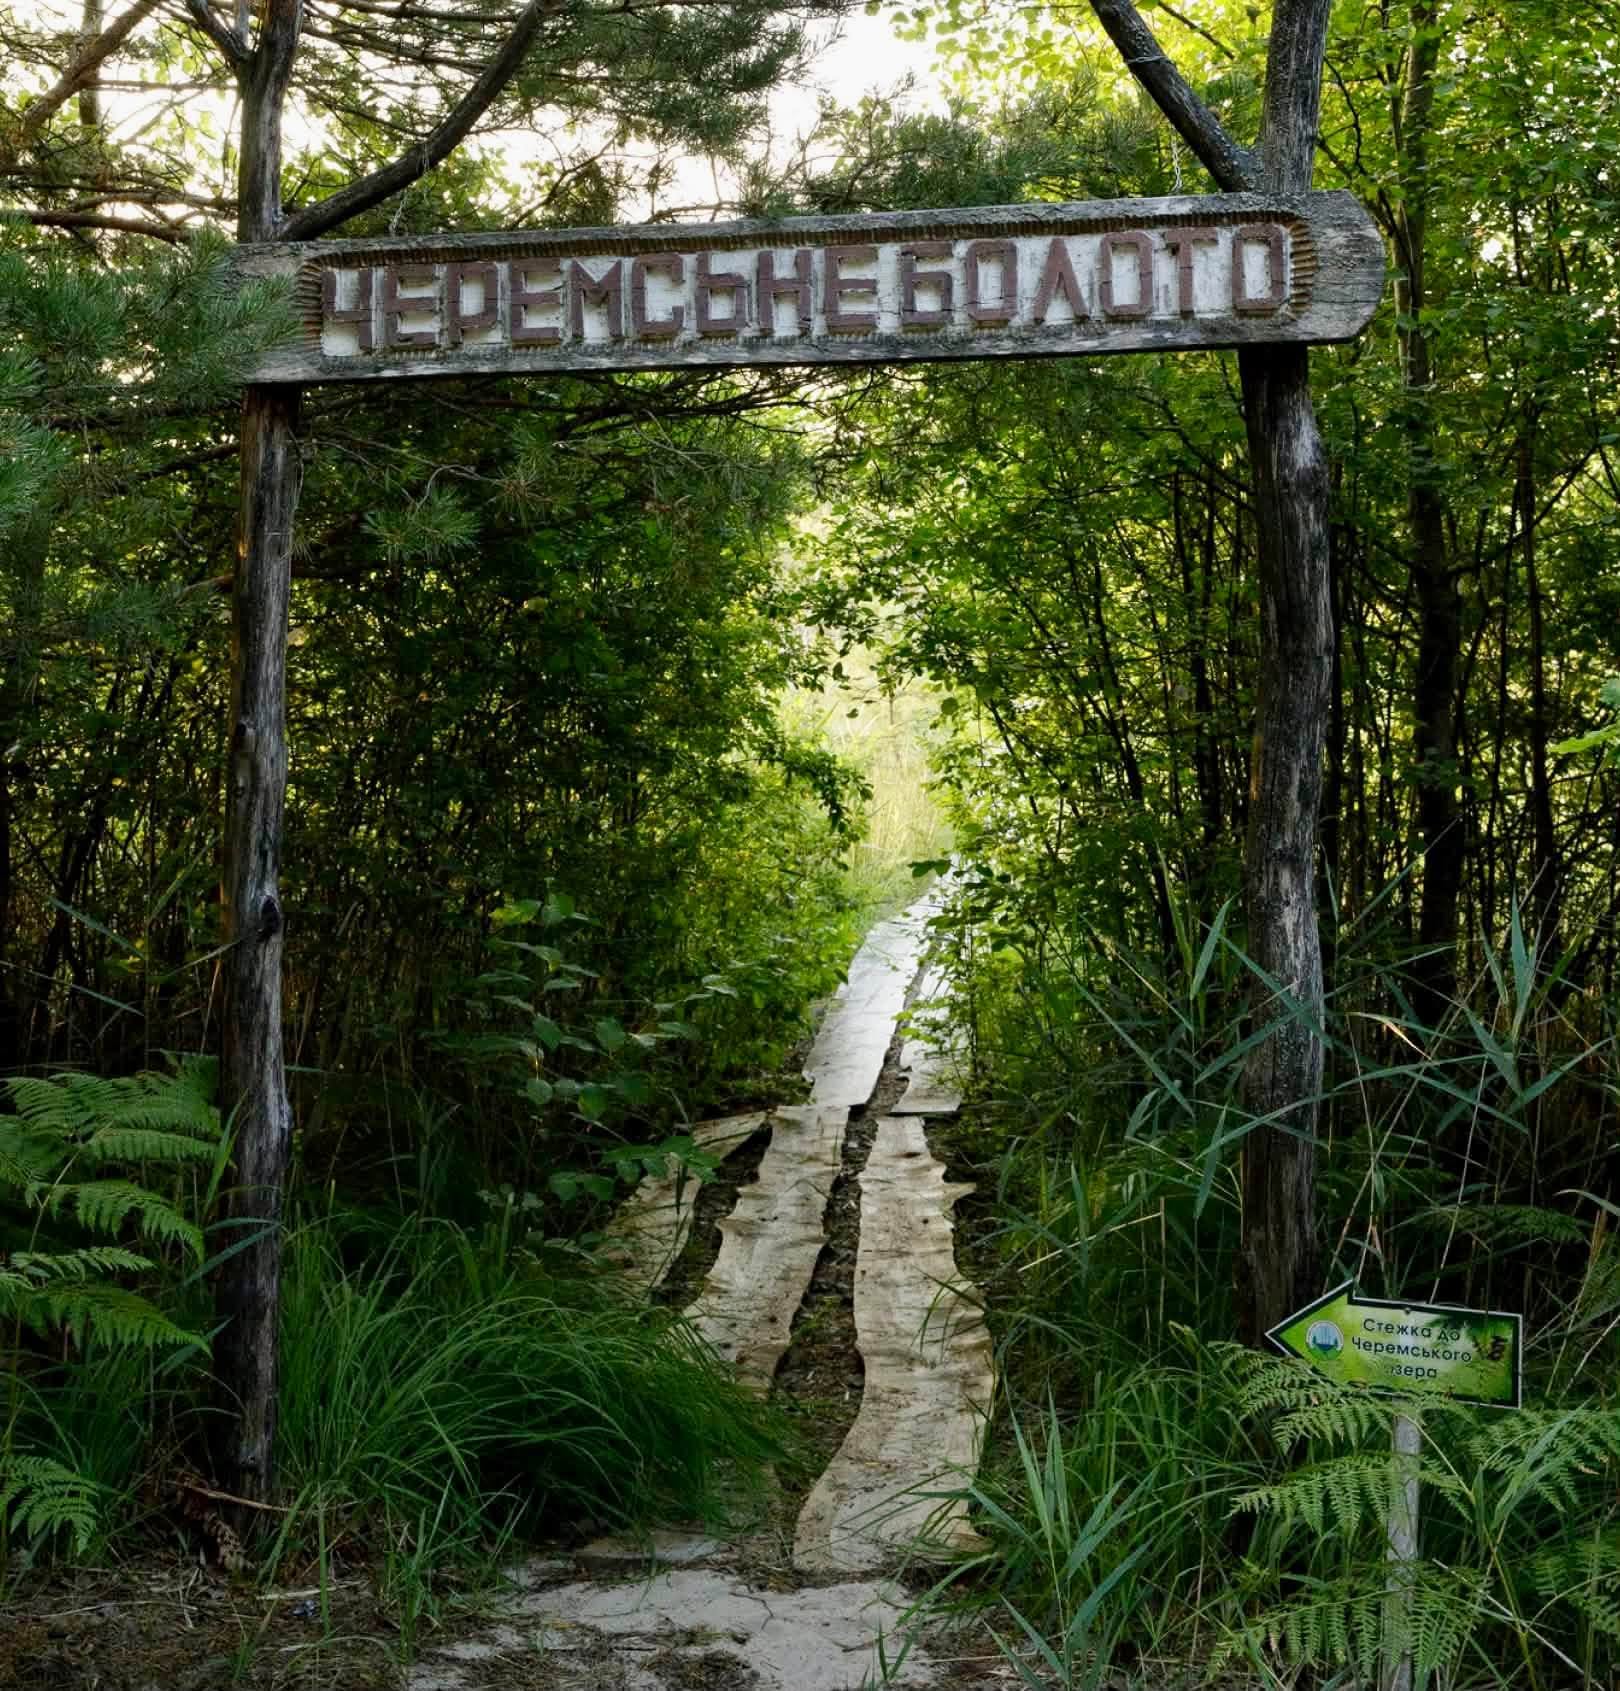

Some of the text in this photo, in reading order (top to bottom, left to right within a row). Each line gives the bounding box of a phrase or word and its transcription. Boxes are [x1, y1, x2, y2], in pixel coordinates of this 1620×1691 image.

[1362, 1317, 1461, 1343] Стежка до
[1351, 1335, 1473, 1363] Черемського
[1385, 1364, 1437, 1380] зера
